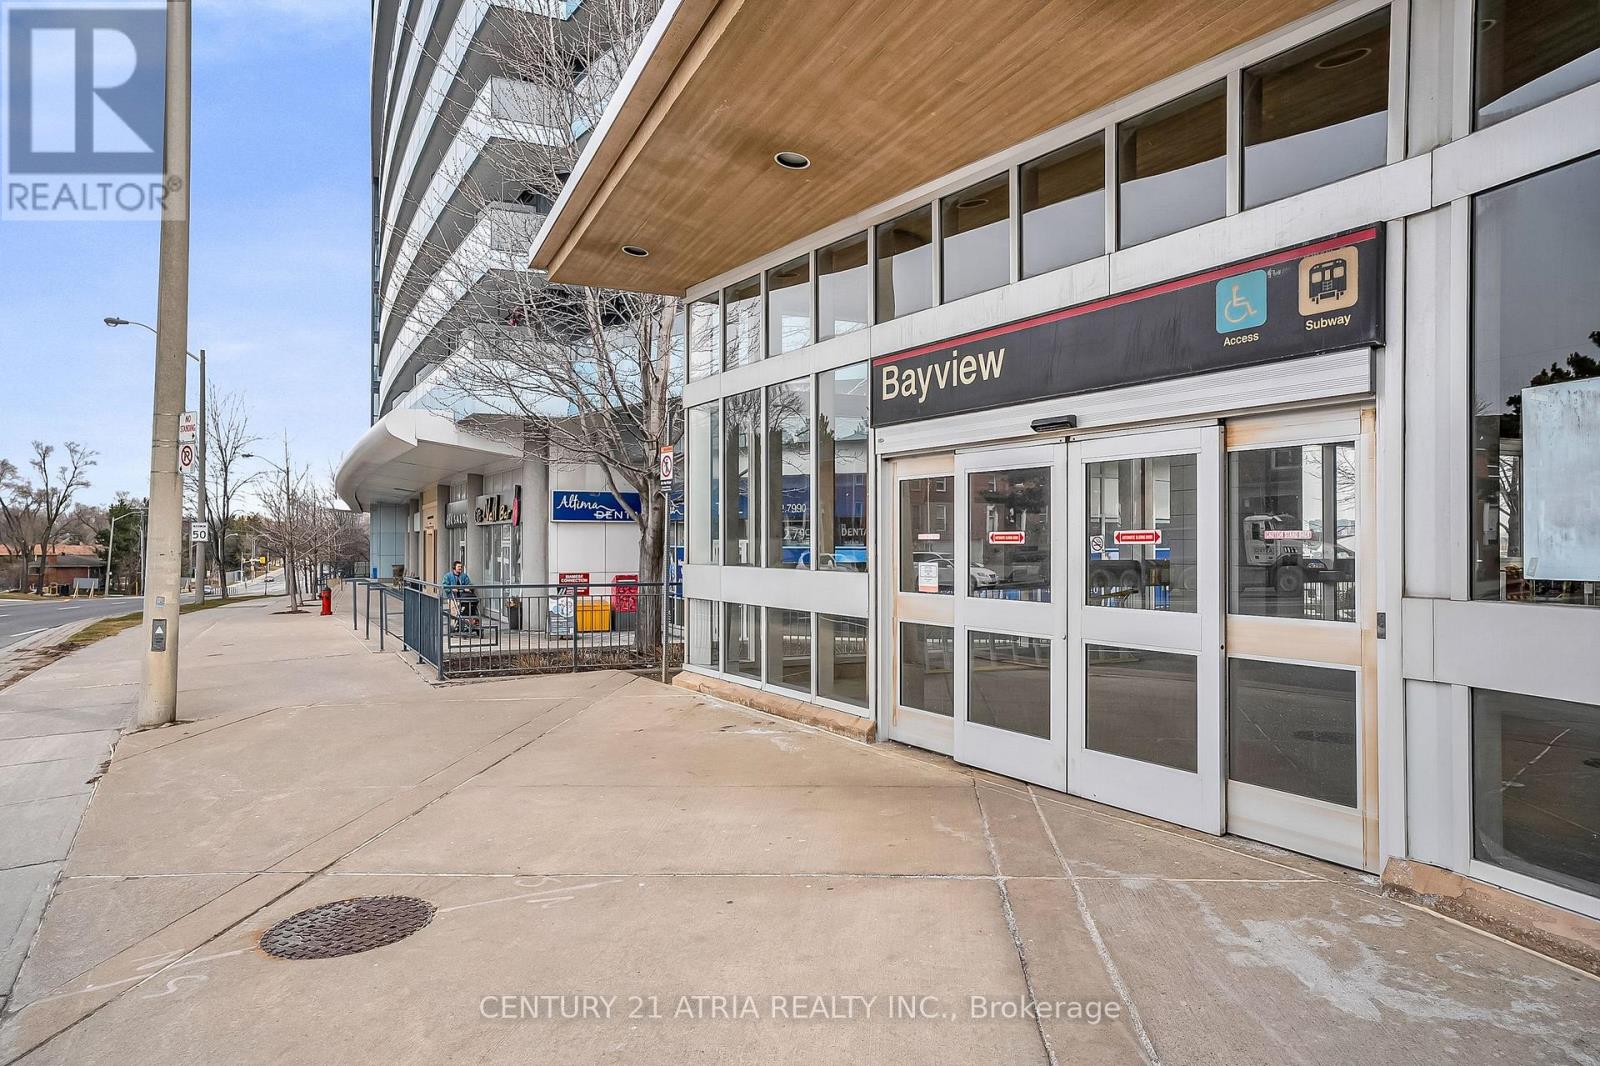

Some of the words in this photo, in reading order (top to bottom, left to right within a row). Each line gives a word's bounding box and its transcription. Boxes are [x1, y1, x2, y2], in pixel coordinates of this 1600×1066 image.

[1305, 313, 1352, 331] Subway
[1223, 332, 1260, 347] Access
[882, 348, 1006, 404] Bayview
[556, 494, 601, 511] Altima
[192, 530, 207, 540] 50
